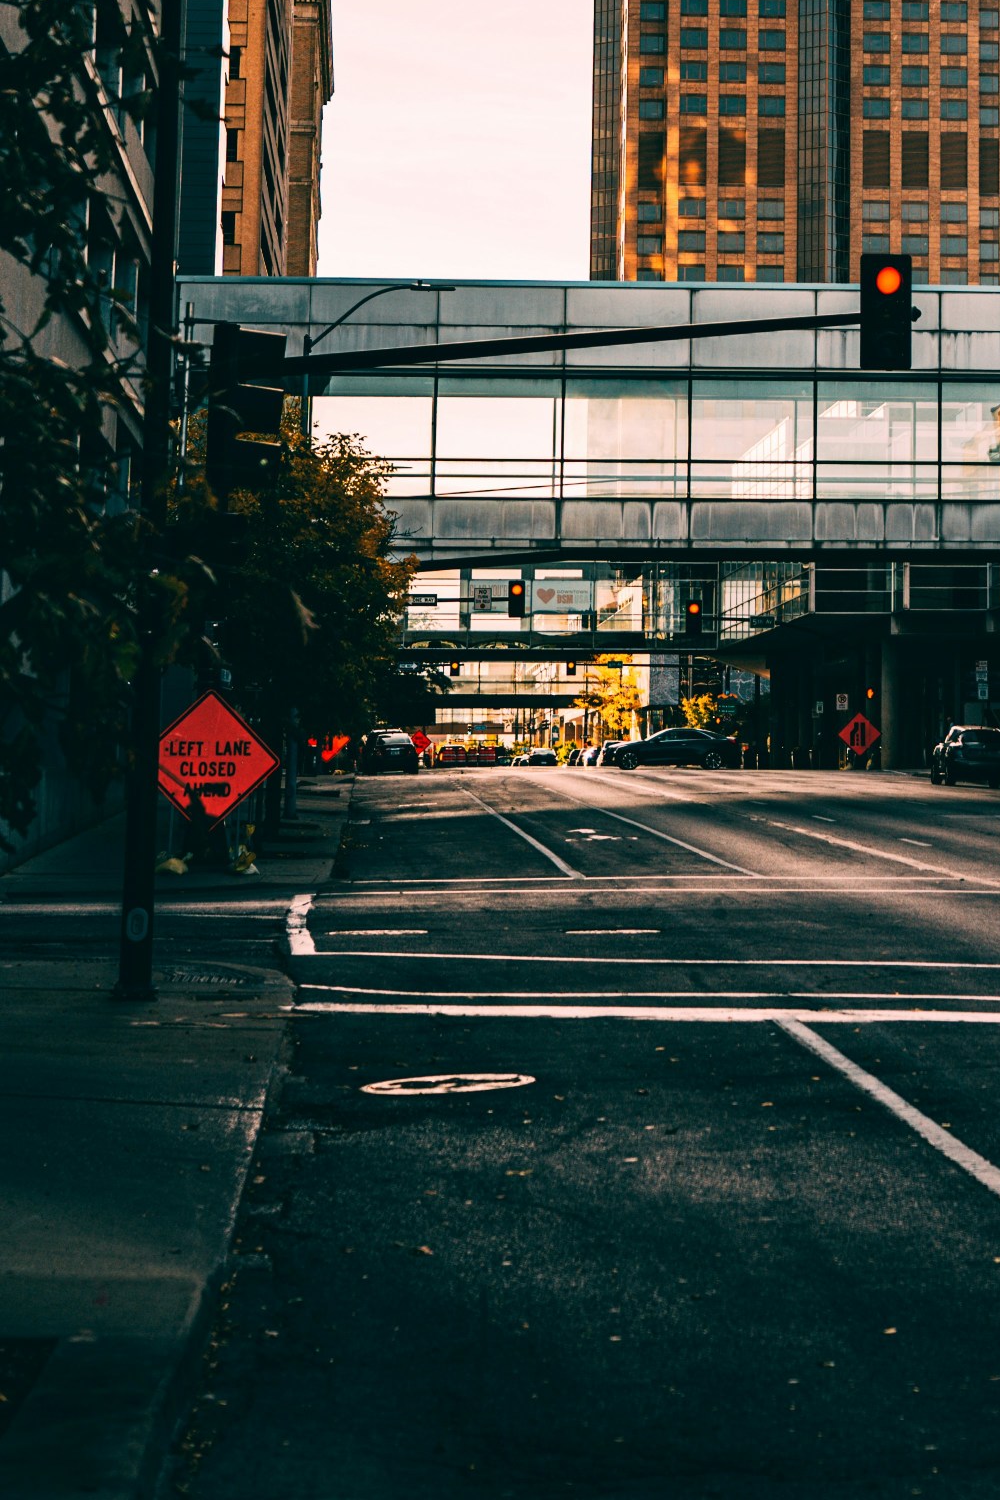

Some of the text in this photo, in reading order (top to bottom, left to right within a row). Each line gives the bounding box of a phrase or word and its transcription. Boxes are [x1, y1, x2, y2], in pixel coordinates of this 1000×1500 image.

[170, 741, 251, 756] LEFT LANE
[180, 762, 236, 777] CLOSED
